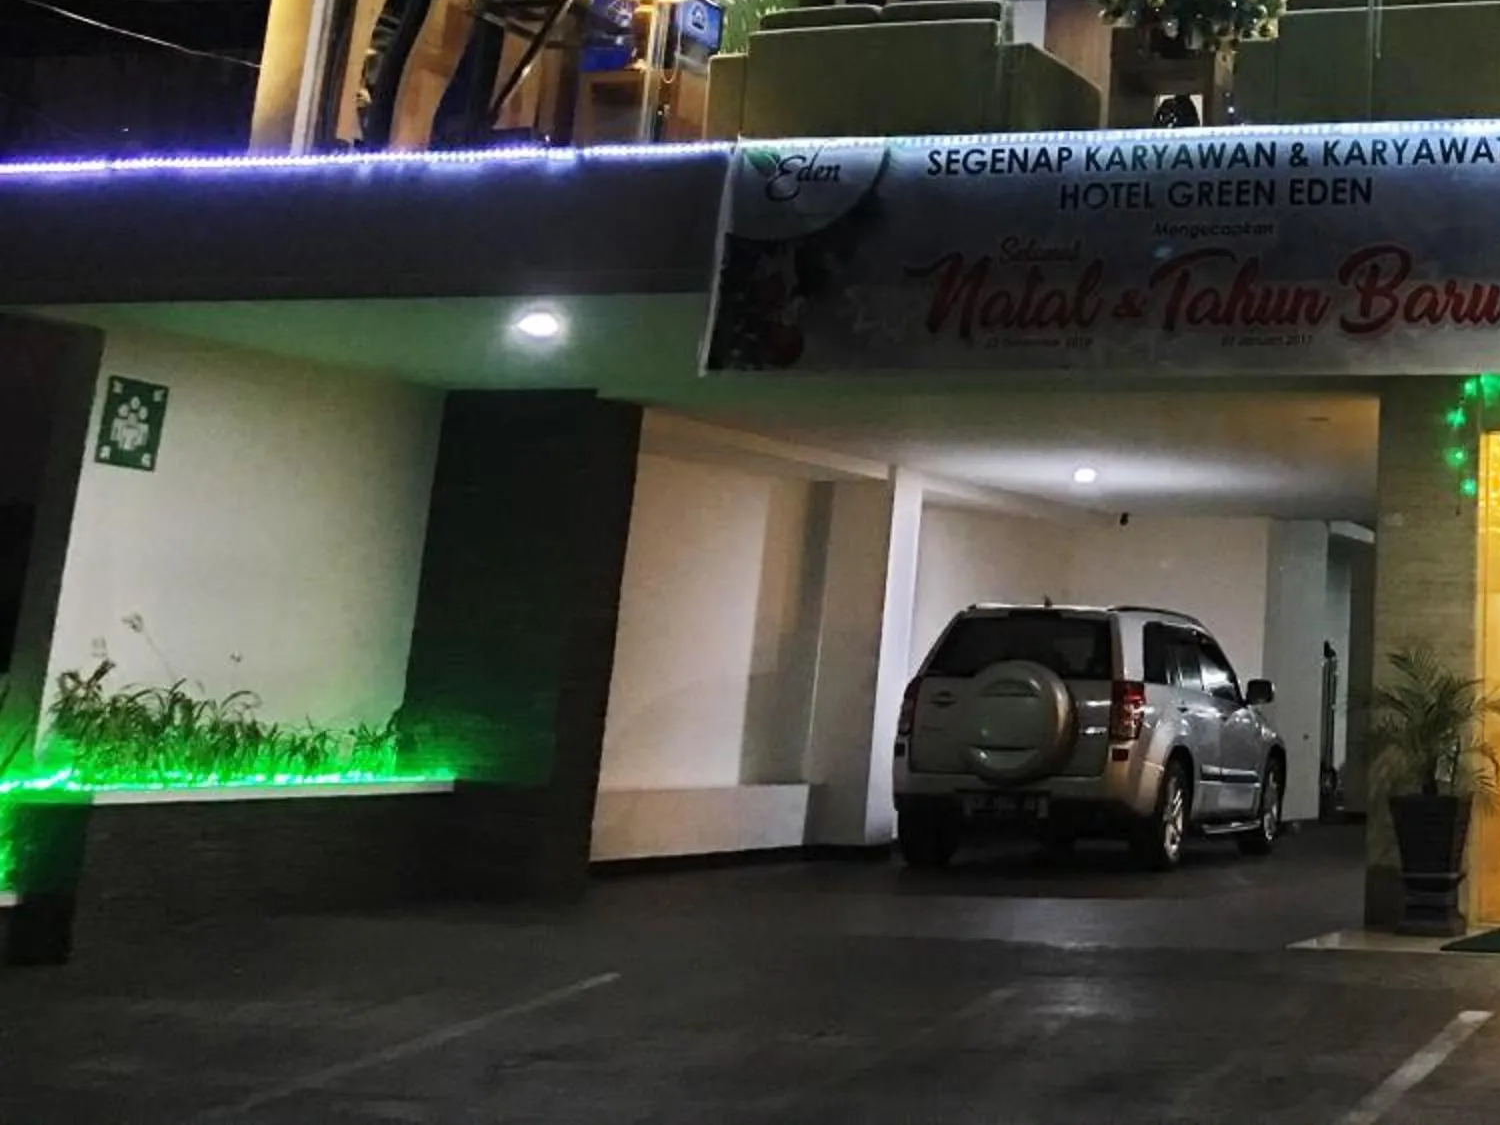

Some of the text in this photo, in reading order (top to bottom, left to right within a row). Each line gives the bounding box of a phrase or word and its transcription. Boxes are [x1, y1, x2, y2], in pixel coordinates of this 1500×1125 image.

[765, 148, 842, 202] Eden
[926, 147, 1074, 177] SEGENAP
[1083, 141, 1278, 173] KARYAWAN
[1289, 141, 1310, 169] &
[1060, 175, 1373, 213] HOTEL GREEN EDEN
[903, 251, 1104, 338] Natal
[1111, 286, 1148, 319] &
[1148, 246, 1332, 331] Tahun
